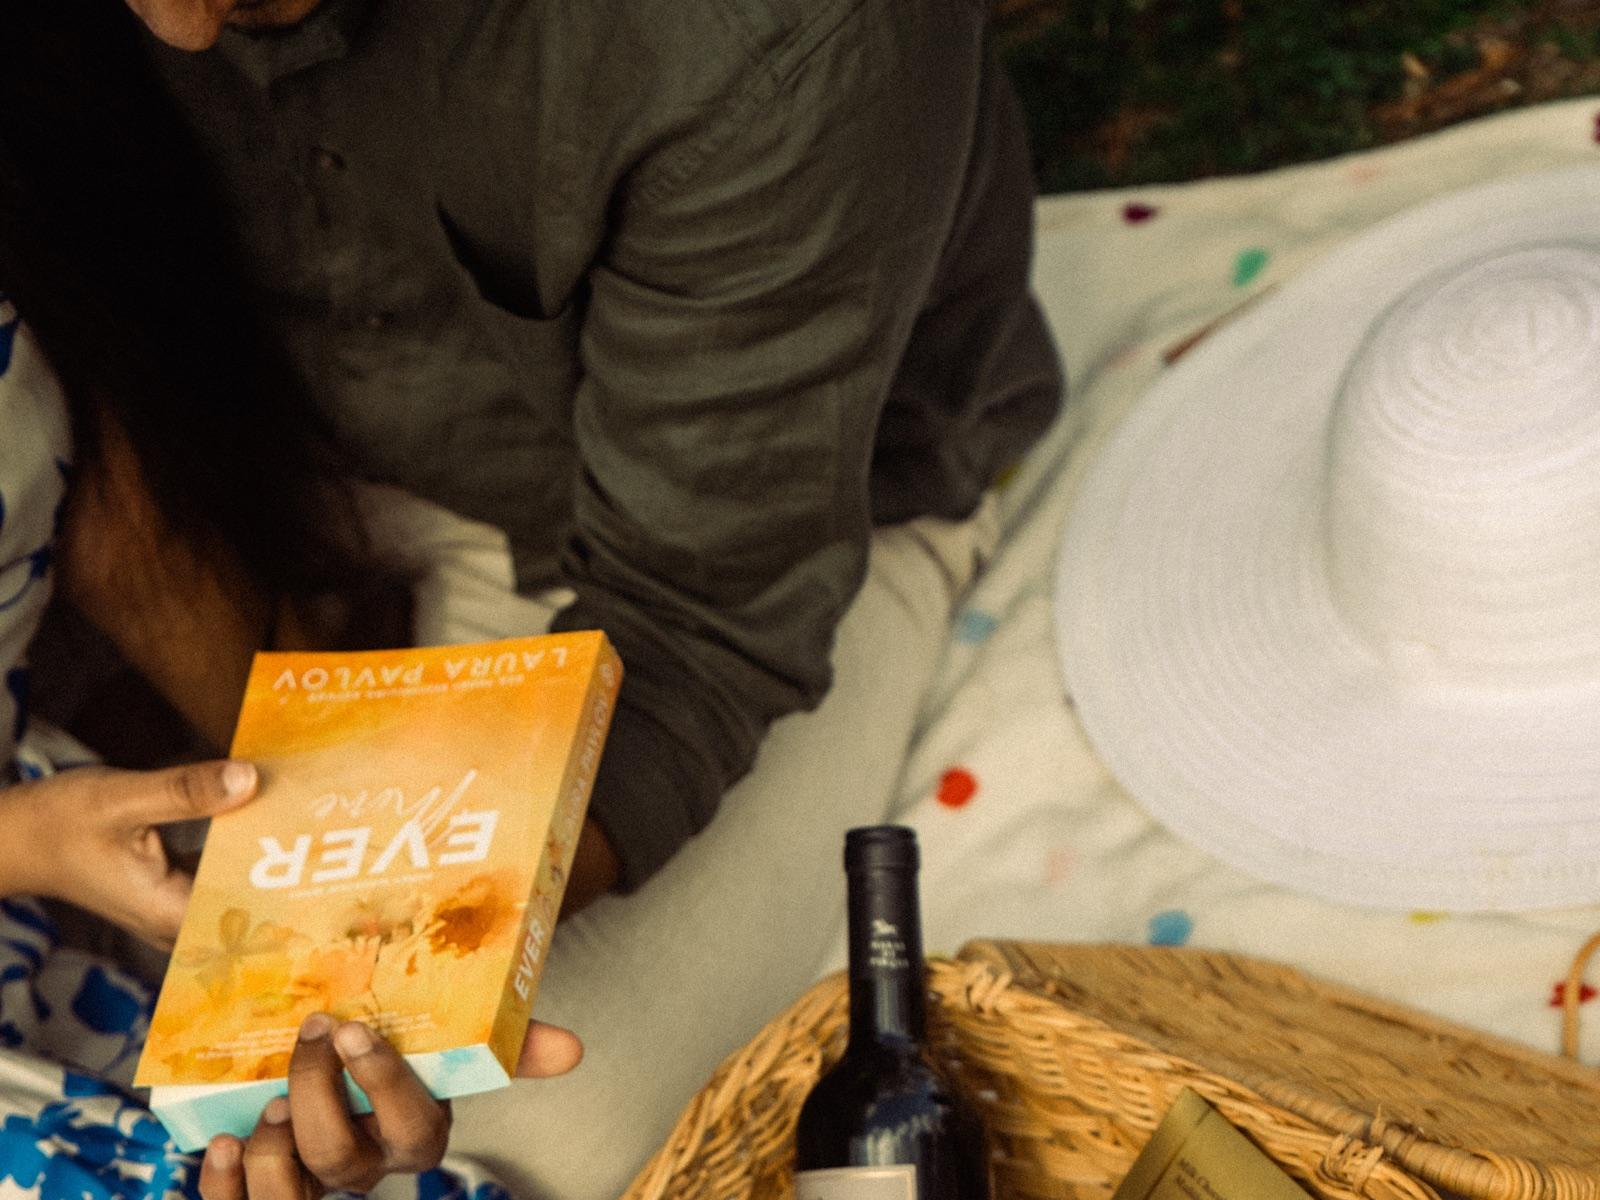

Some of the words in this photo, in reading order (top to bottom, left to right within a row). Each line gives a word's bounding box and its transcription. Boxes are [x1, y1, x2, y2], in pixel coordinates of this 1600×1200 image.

[272, 662, 424, 694] PAVLOV
[443, 646, 568, 681] LAURA
[249, 809, 498, 889] EVER
[514, 917, 546, 1001] EVER
